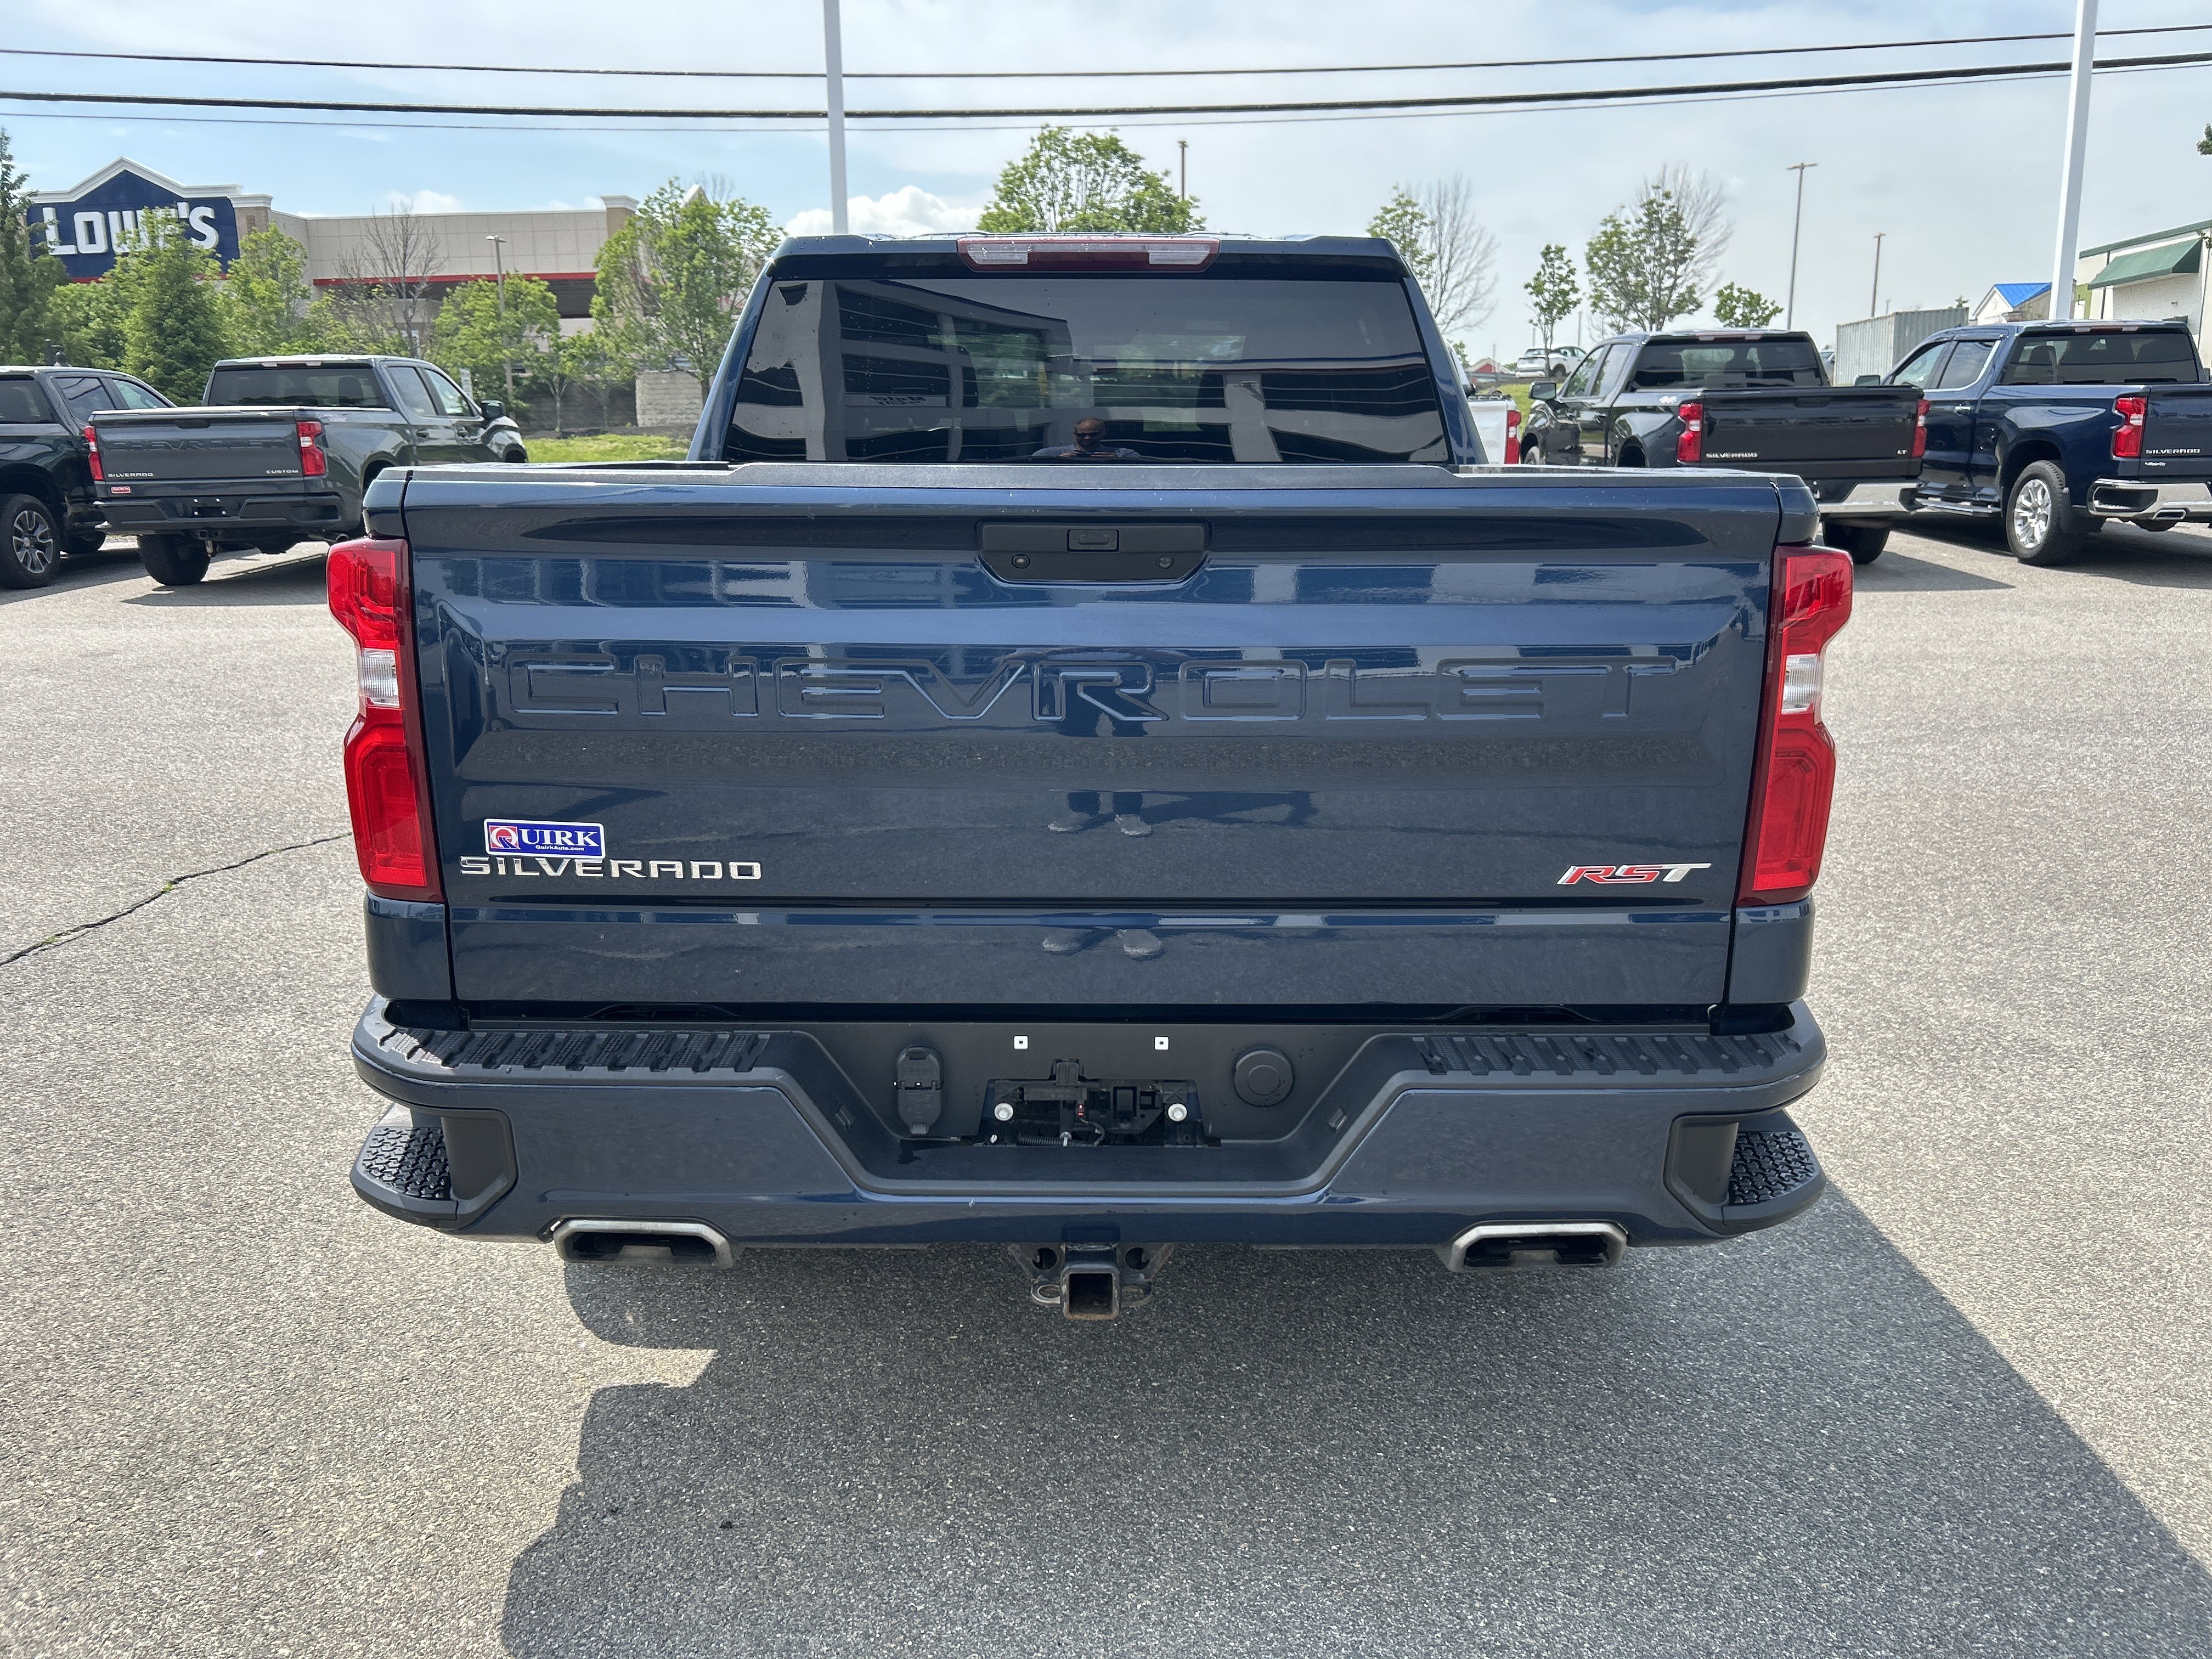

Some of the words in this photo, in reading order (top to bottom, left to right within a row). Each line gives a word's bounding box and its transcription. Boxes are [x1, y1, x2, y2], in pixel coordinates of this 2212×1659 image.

[507, 653, 1677, 721] CHEVROLET
[490, 826, 600, 849] QUIRK
[459, 855, 762, 879] SILVERADO
[1556, 863, 1712, 885] RST
